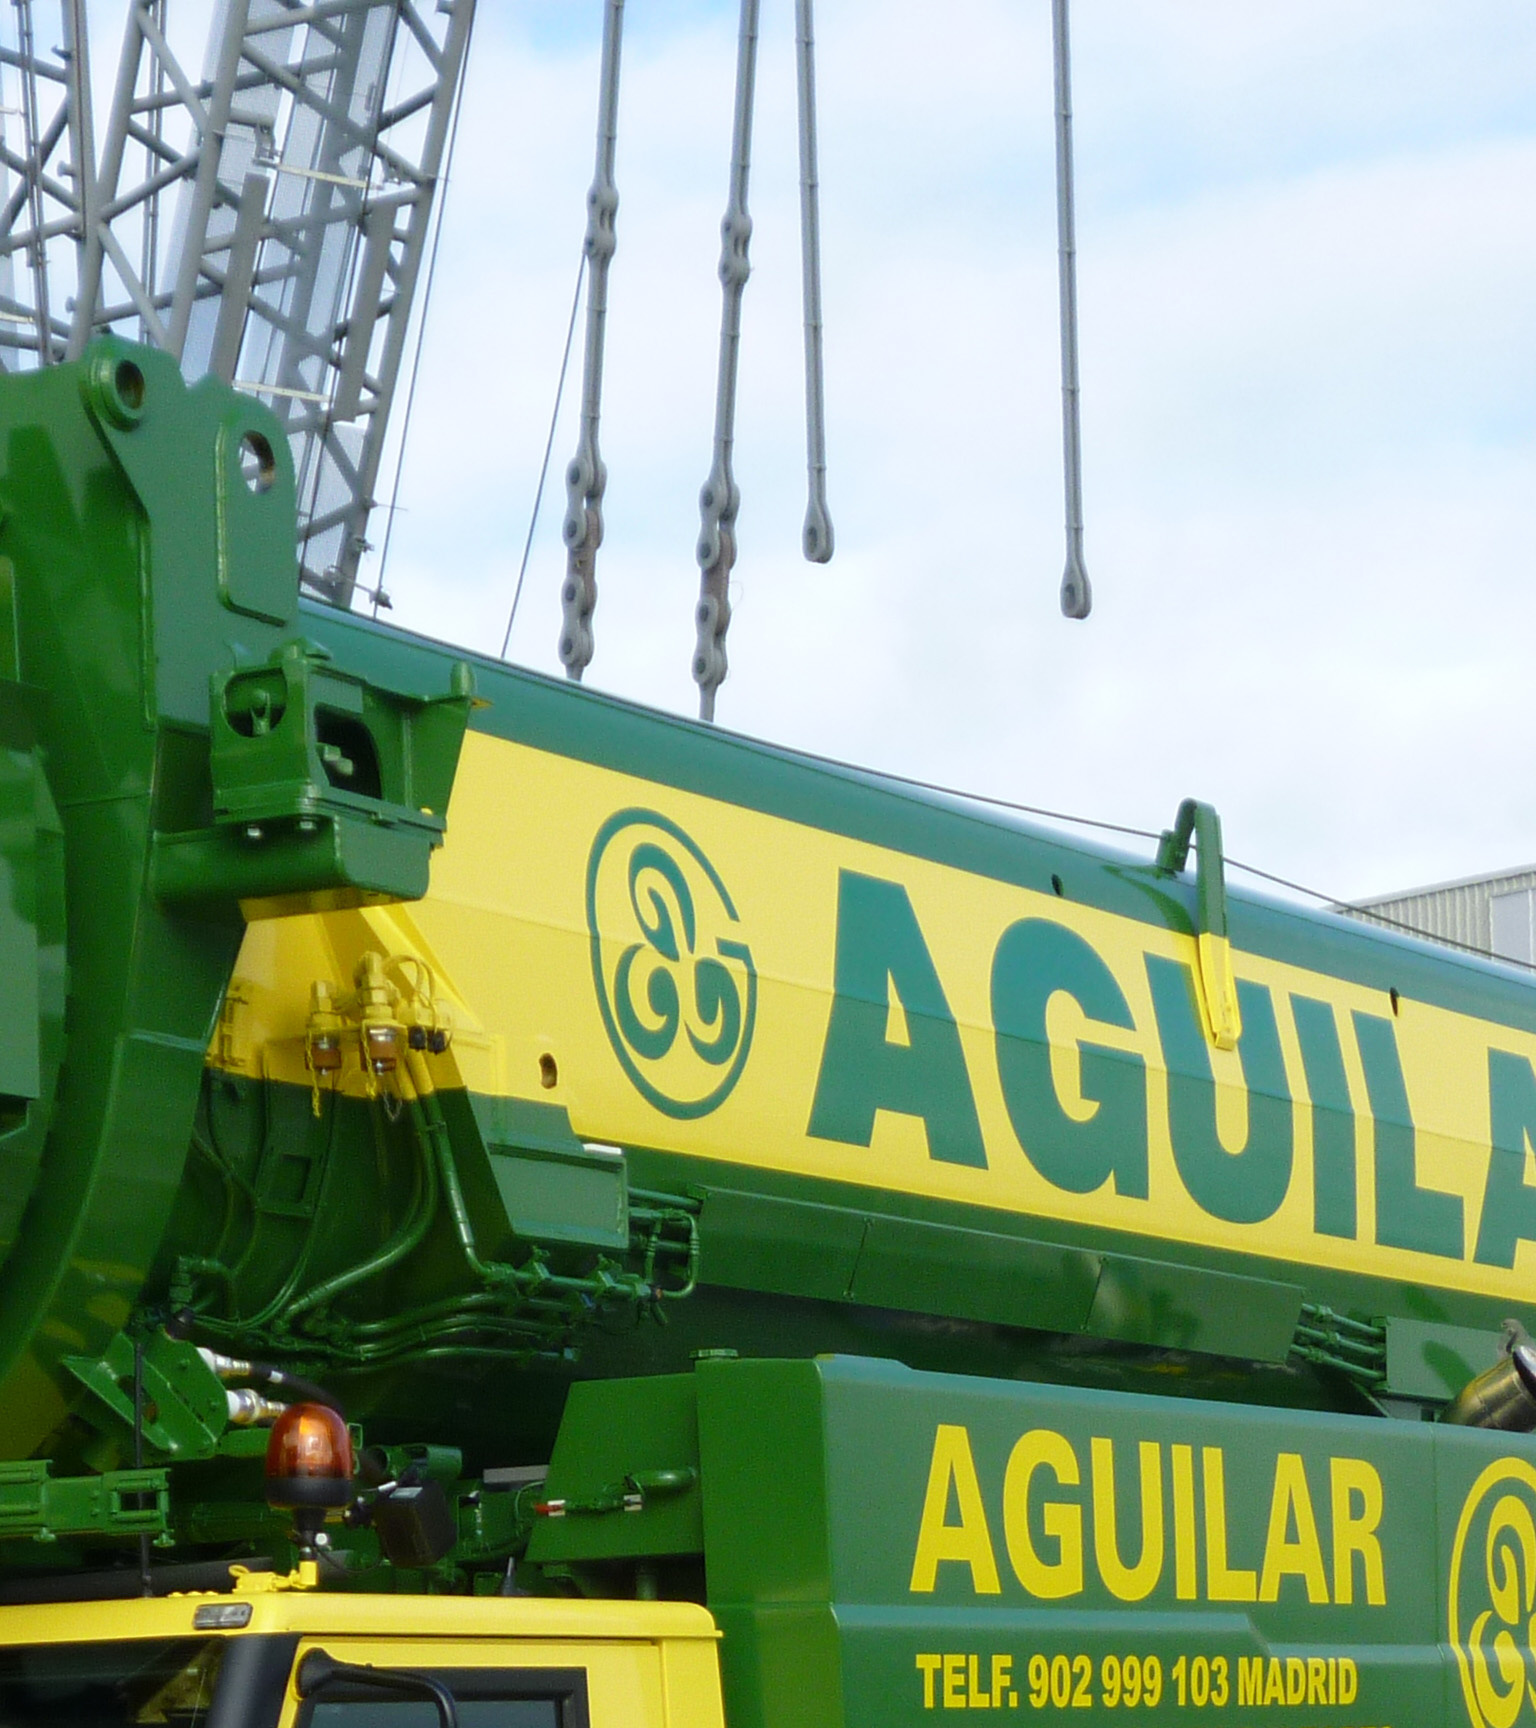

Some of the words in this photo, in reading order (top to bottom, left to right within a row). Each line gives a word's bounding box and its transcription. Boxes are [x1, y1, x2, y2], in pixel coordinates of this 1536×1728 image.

[910, 1424, 1387, 1607] AGUILAR
[916, 1653, 1019, 1709] TELF.
[1027, 1654, 1093, 1709] 902
[1100, 1654, 1163, 1708] 999
[1171, 1655, 1230, 1707] 103
[1237, 1656, 1358, 1706] MADRID
